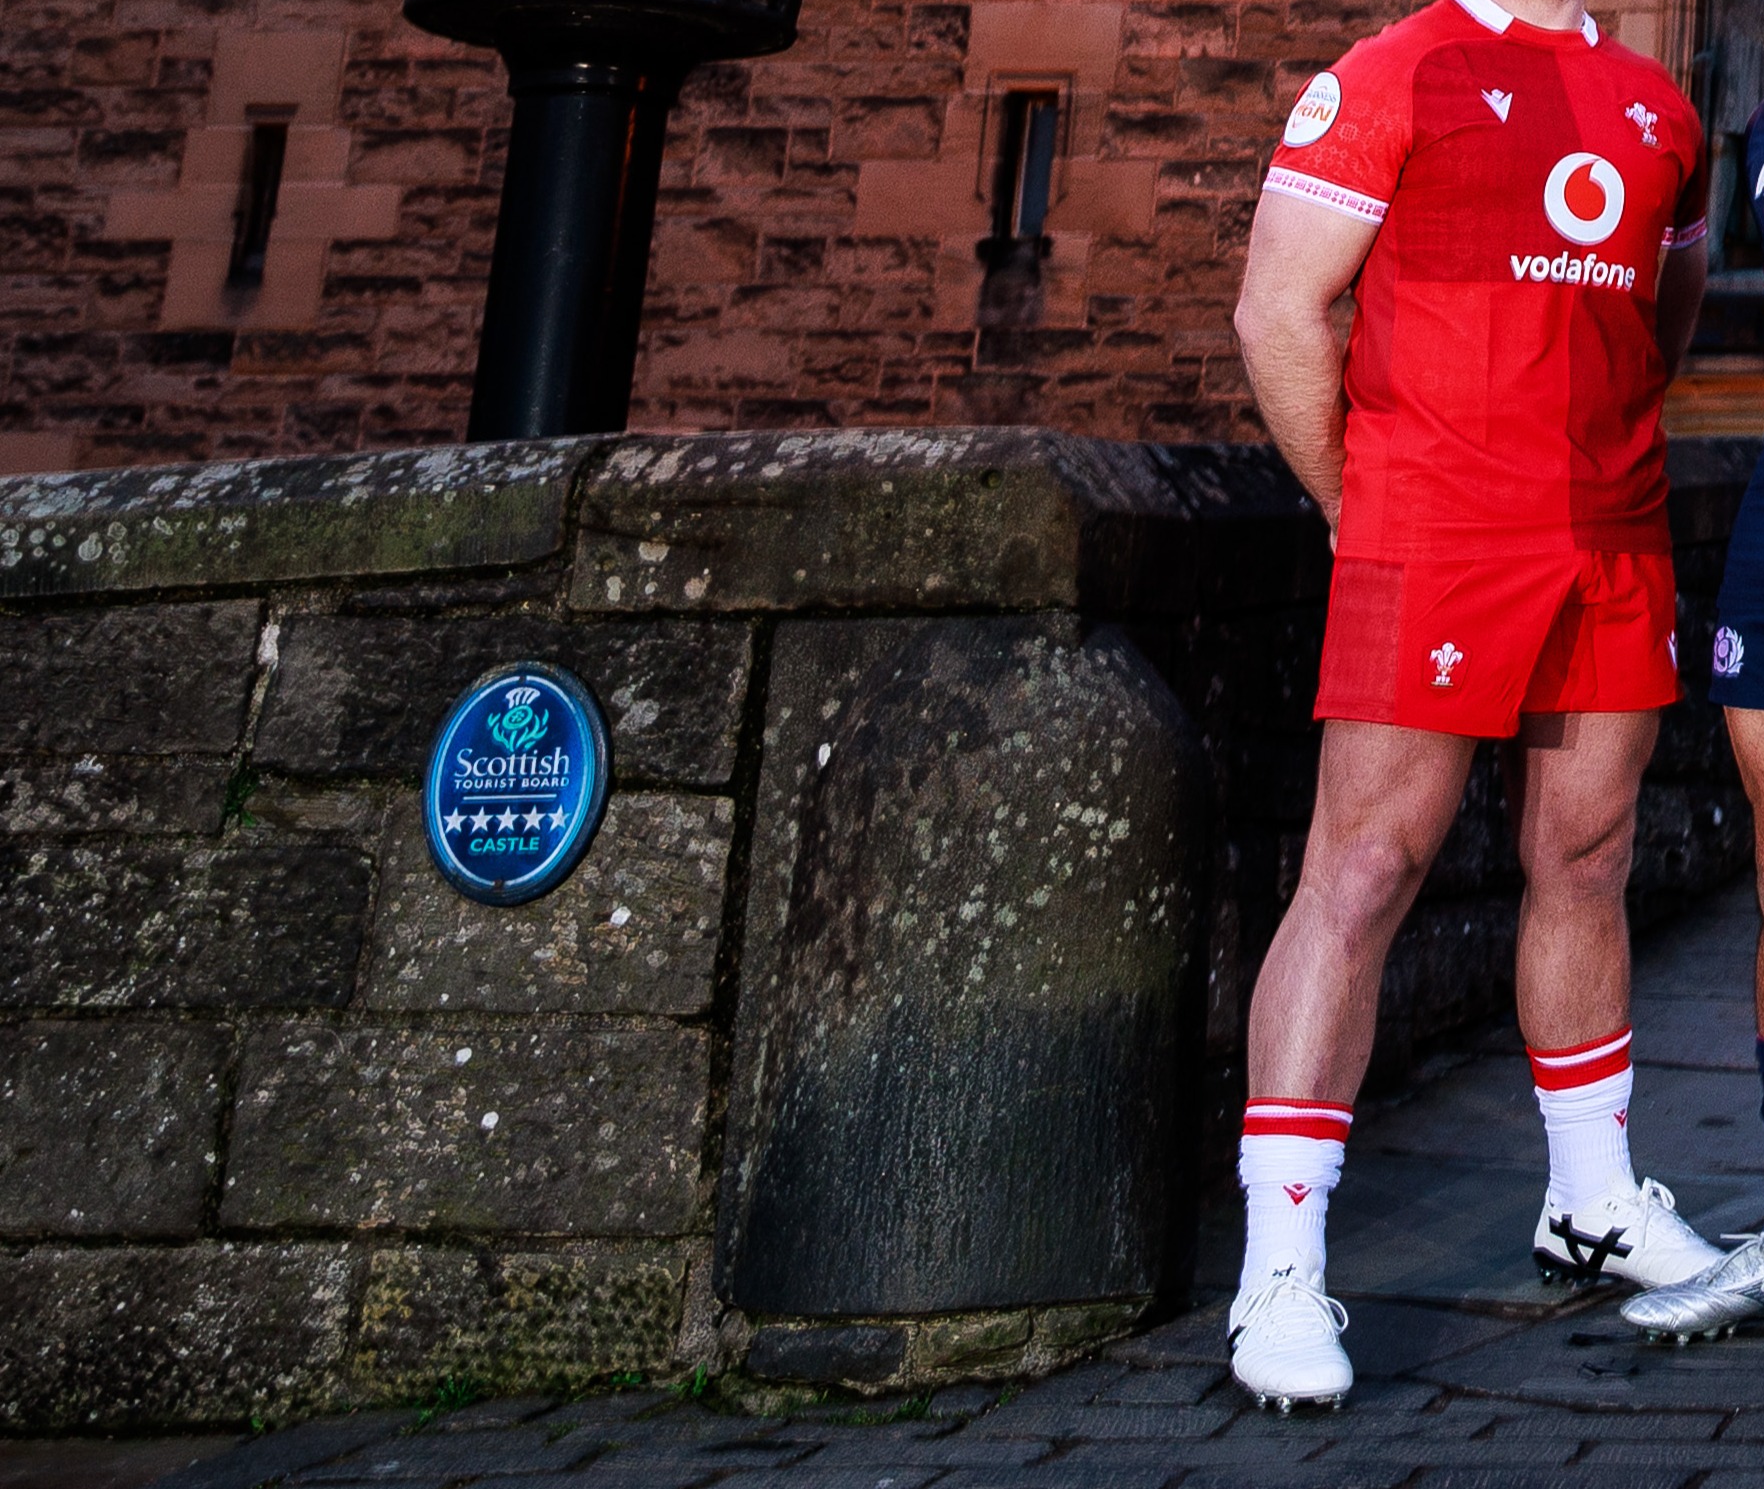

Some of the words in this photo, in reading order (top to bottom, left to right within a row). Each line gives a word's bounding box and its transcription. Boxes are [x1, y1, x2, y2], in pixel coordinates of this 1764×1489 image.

[1510, 250, 1636, 291] vodafone
[454, 747, 570, 778] Scottish
[454, 777, 516, 789] TOURIST
[521, 777, 570, 788] BOARD
[470, 836, 540, 853] CASTLE
